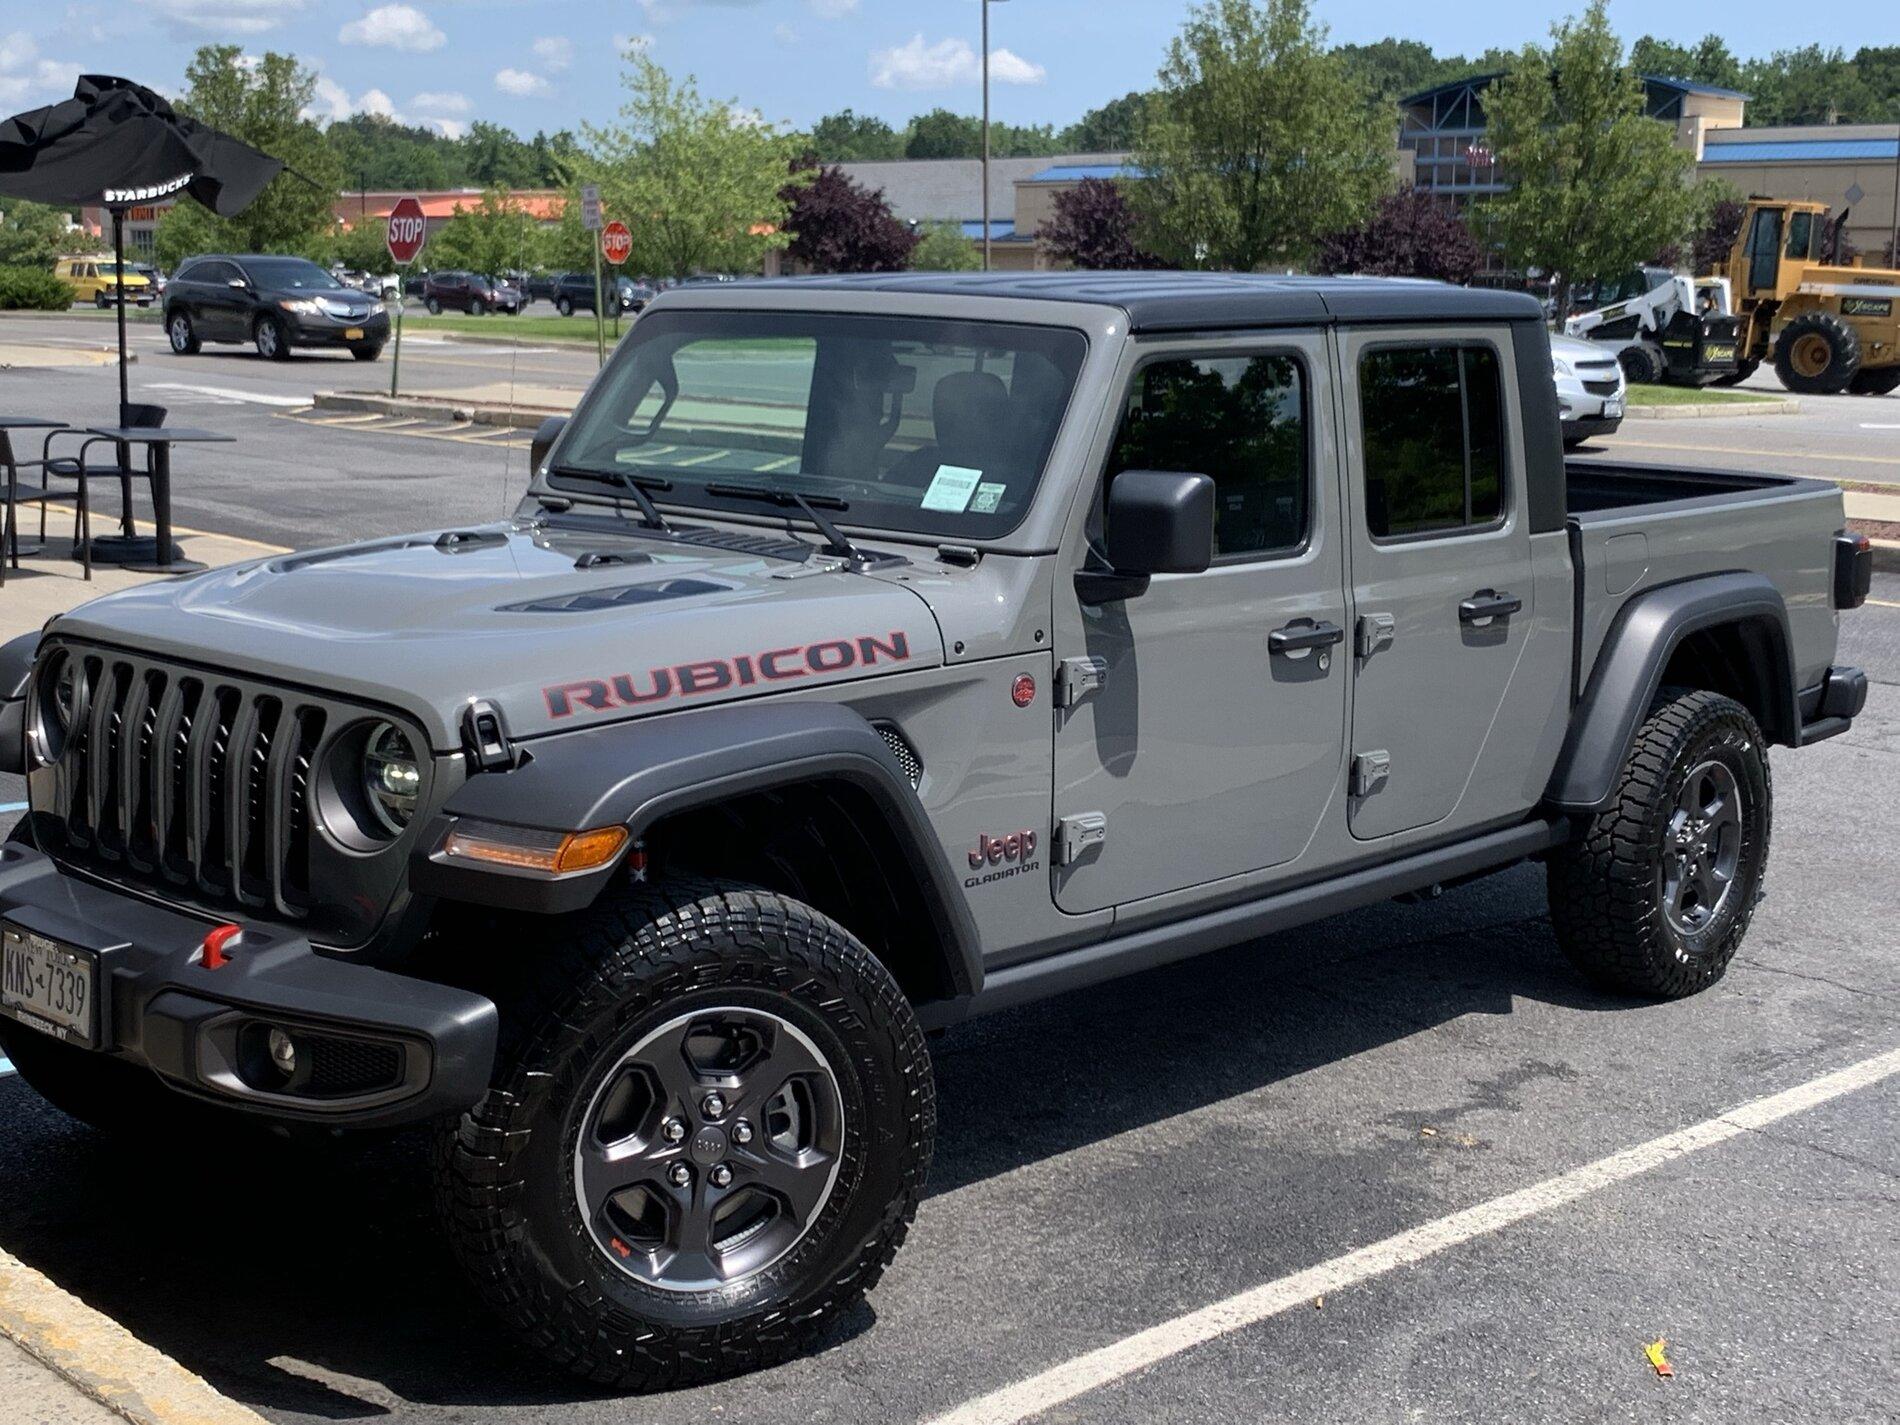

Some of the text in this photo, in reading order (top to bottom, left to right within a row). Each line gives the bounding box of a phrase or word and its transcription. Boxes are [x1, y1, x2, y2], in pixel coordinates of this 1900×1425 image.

[104, 173, 191, 202] STARBUCKS
[390, 217, 423, 243] STOP
[605, 233, 629, 251] STOP
[542, 632, 911, 719] RUBICON
[967, 829, 1037, 871] Jeep
[964, 861, 1040, 888] GLADIATOR
[5, 947, 85, 1017] KNS 7339
